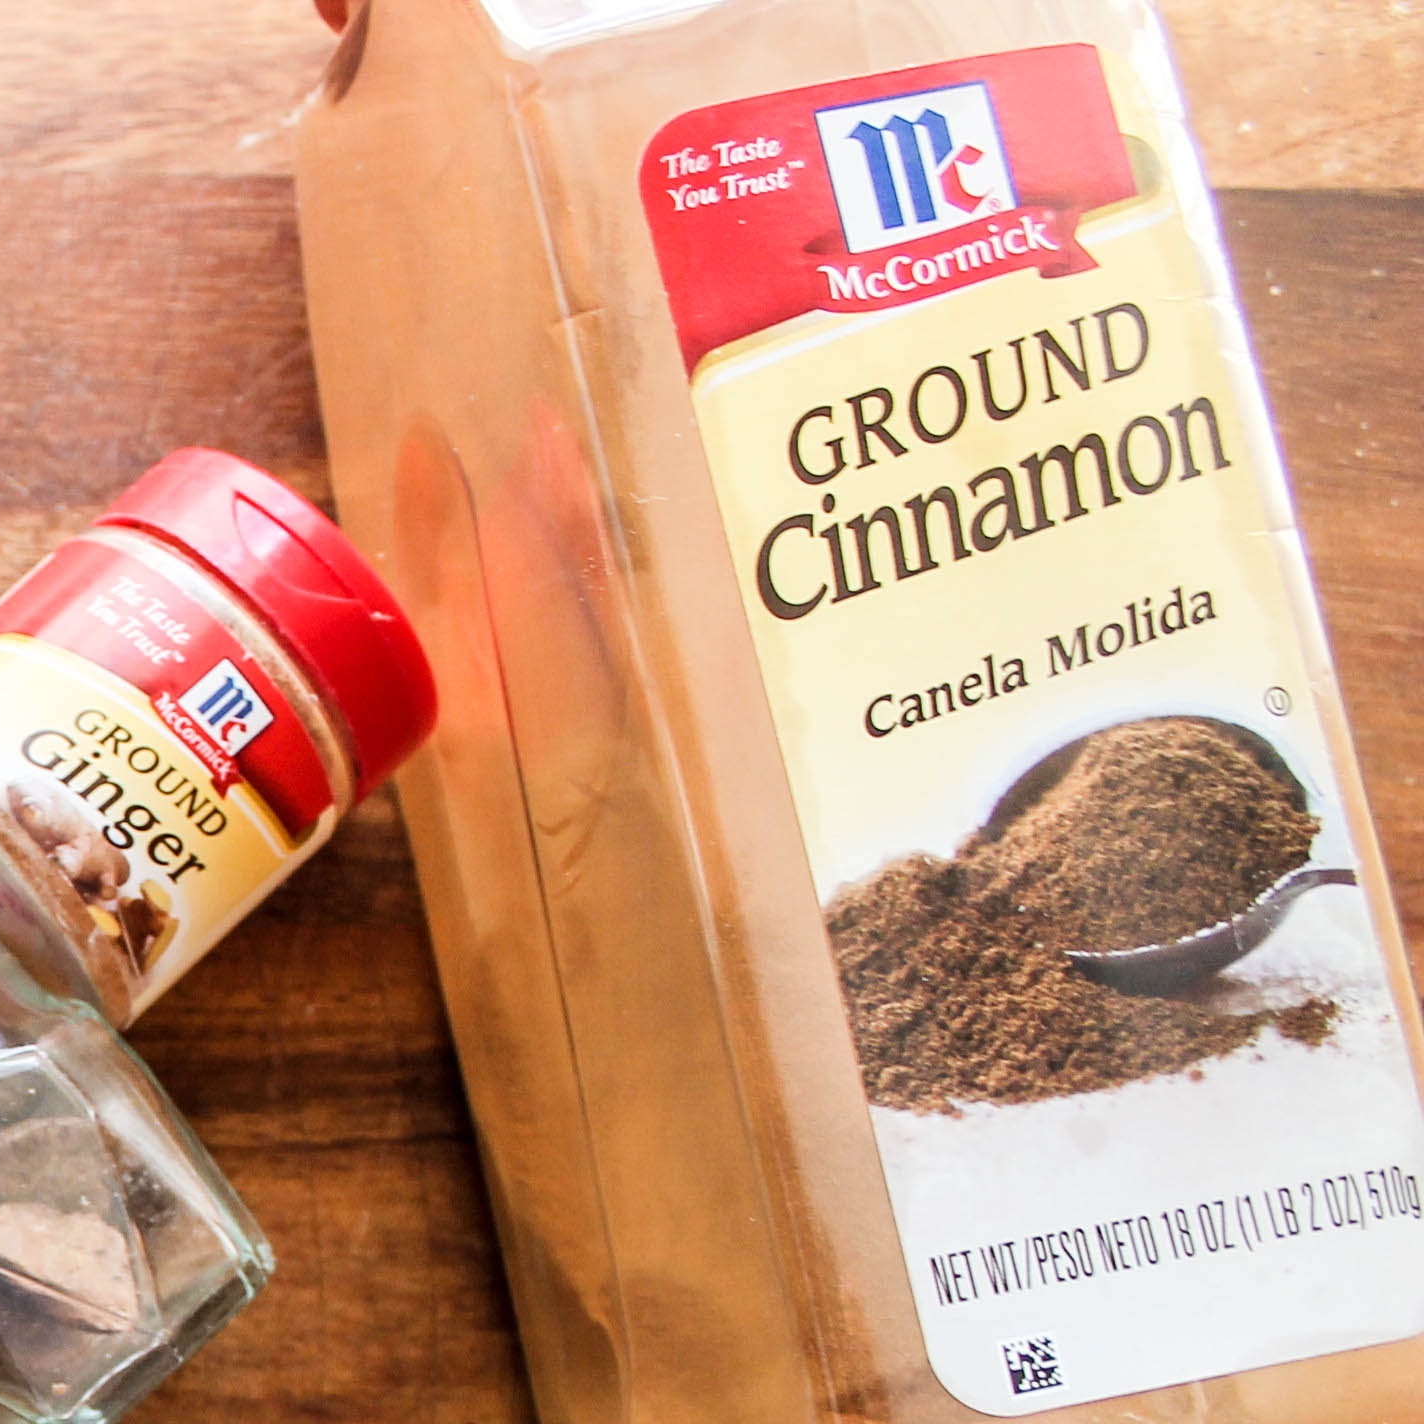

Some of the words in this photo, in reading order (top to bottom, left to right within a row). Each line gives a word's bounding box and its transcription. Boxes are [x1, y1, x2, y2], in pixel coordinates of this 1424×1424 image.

[660, 147, 711, 181] The
[711, 136, 784, 168] Taste
[665, 186, 721, 213] You
[816, 214, 1060, 302] McCormick
[788, 301, 1152, 488] GROUND
[756, 395, 1234, 622] Cinnamon
[86, 593, 122, 626] You
[110, 574, 146, 608] The
[140, 597, 193, 646] Taste
[862, 655, 1030, 739] Canela
[1046, 586, 1219, 681] Molida
[73, 707, 230, 839] GROUND
[153, 690, 234, 782] McCormick
[20, 728, 208, 886] Ginger
[928, 1249, 980, 1307] NET
[978, 1227, 1096, 1296] WT/PESO
[1094, 1215, 1161, 1274] NETO
[1160, 1208, 1197, 1260] 18
[1196, 1200, 1236, 1254] OZ
[1235, 1195, 1264, 1253] (1
[1262, 1187, 1301, 1240] LB
[1301, 1182, 1324, 1232] 2
[1321, 1172, 1367, 1231] OZ)
[1364, 1164, 1423, 1220] 510g
